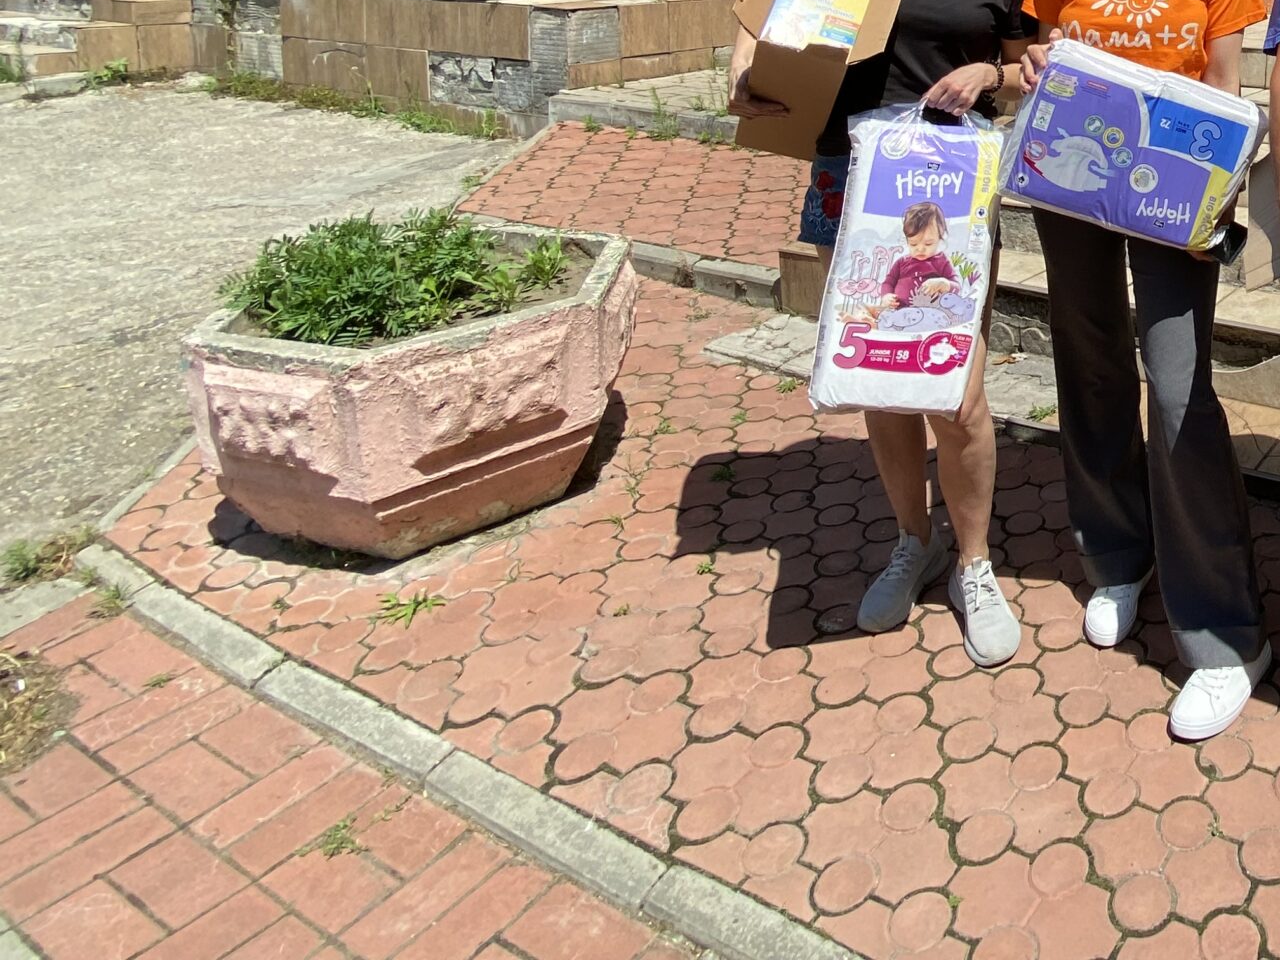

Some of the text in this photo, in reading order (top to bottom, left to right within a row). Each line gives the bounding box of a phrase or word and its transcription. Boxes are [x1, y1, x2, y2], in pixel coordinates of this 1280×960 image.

[1160, 118, 1171, 129] 72
[1189, 119, 1222, 160] 3
[981, 176, 991, 193] BIG
[1205, 195, 1217, 212] BIG
[832, 322, 871, 369] 5
[896, 350, 910, 360] 58
